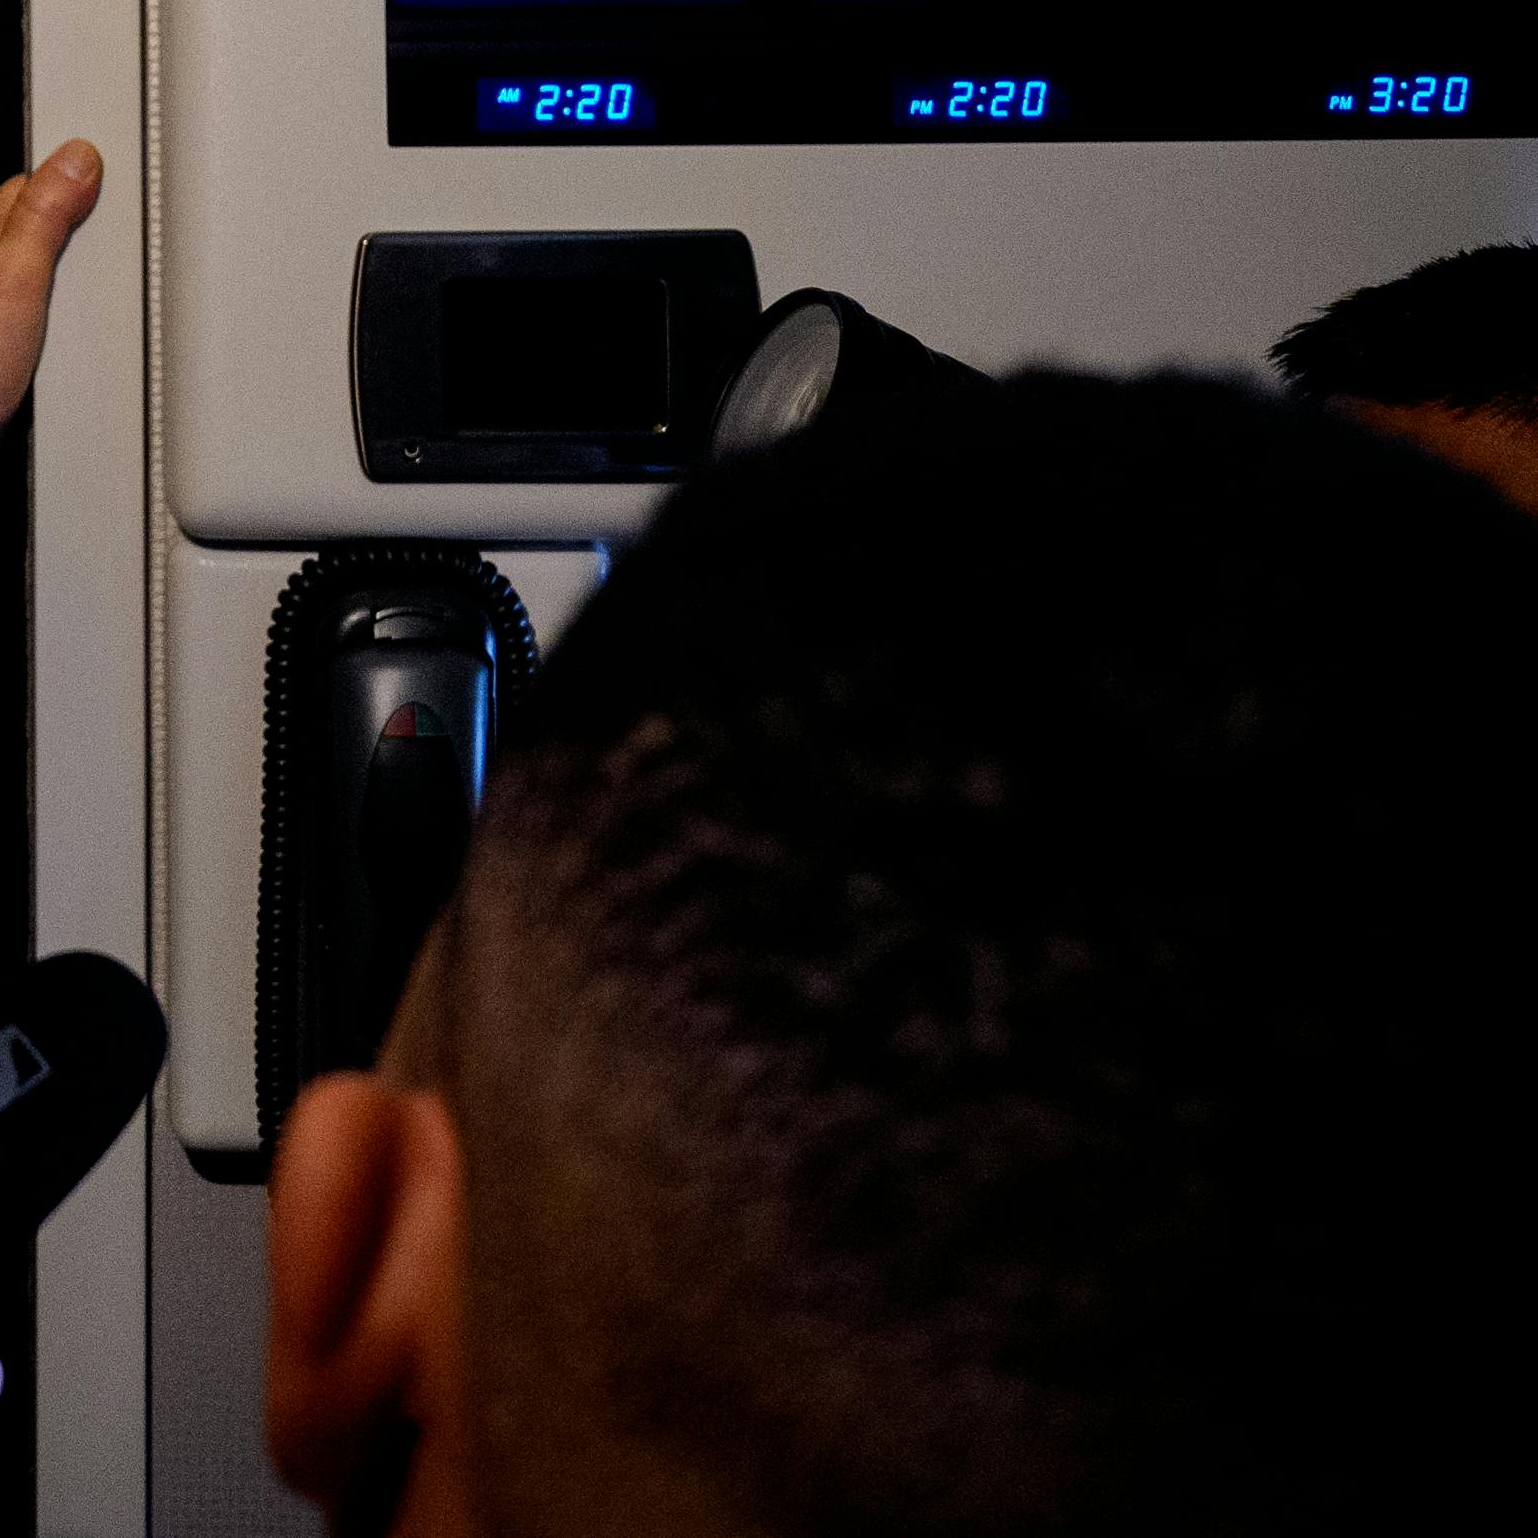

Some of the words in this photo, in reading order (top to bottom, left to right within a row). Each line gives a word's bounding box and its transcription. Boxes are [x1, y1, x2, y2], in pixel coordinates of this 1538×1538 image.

[496, 87, 522, 104] AM
[534, 83, 633, 121] 2:20
[909, 99, 934, 115] PM
[947, 80, 1048, 118] 2:20
[1328, 95, 1354, 111] PM
[1368, 76, 1470, 113] 3:20
